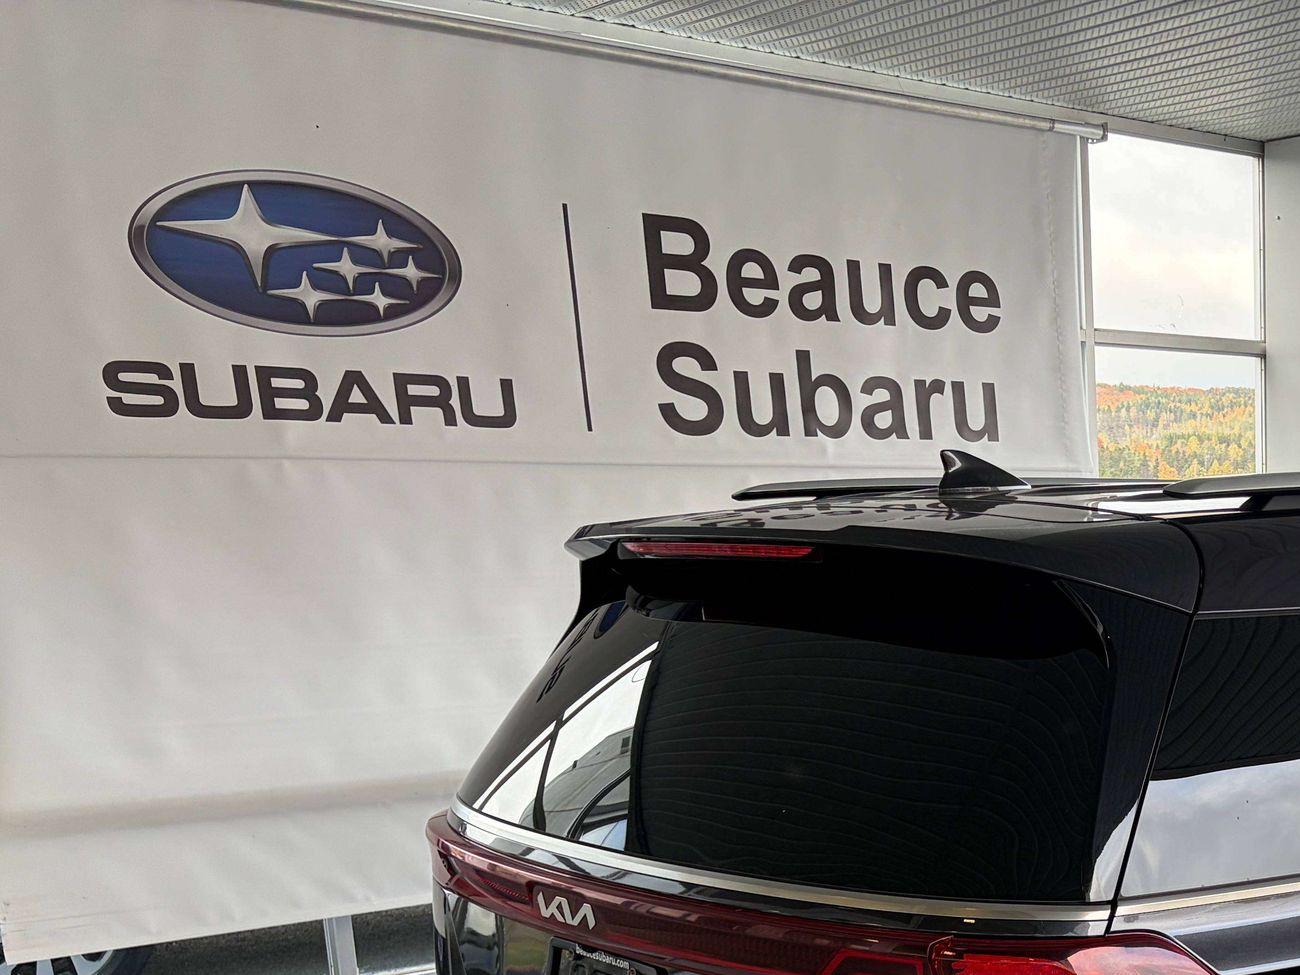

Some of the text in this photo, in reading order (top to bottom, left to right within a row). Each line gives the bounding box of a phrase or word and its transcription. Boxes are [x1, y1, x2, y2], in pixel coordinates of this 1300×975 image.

[639, 211, 1003, 334] Beauce
[101, 358, 519, 429] SUBARU
[654, 338, 1001, 443] Subaru
[536, 890, 597, 930] KIA
